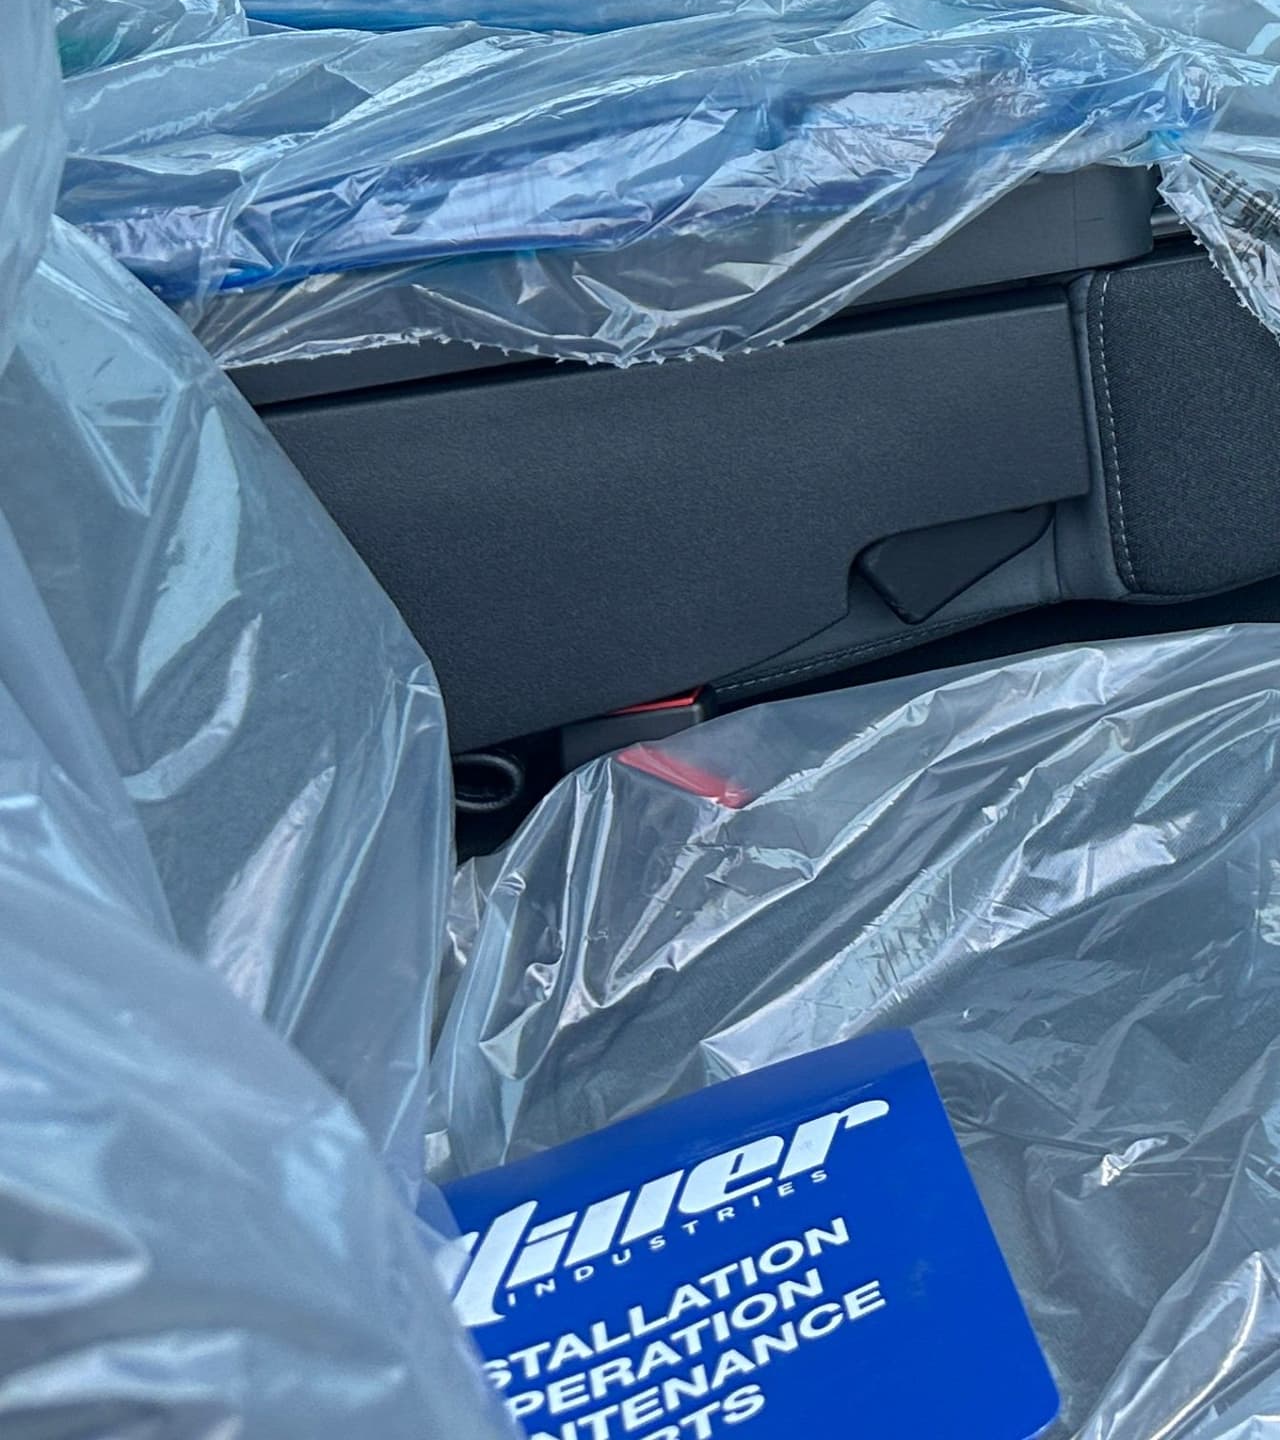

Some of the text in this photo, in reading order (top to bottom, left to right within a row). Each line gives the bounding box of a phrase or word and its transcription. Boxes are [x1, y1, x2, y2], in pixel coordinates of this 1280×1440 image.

[482, 1216, 851, 1390] STALLATION
[507, 1168, 829, 1308] INDUSTRIES
[503, 1267, 824, 1417] PERATION
